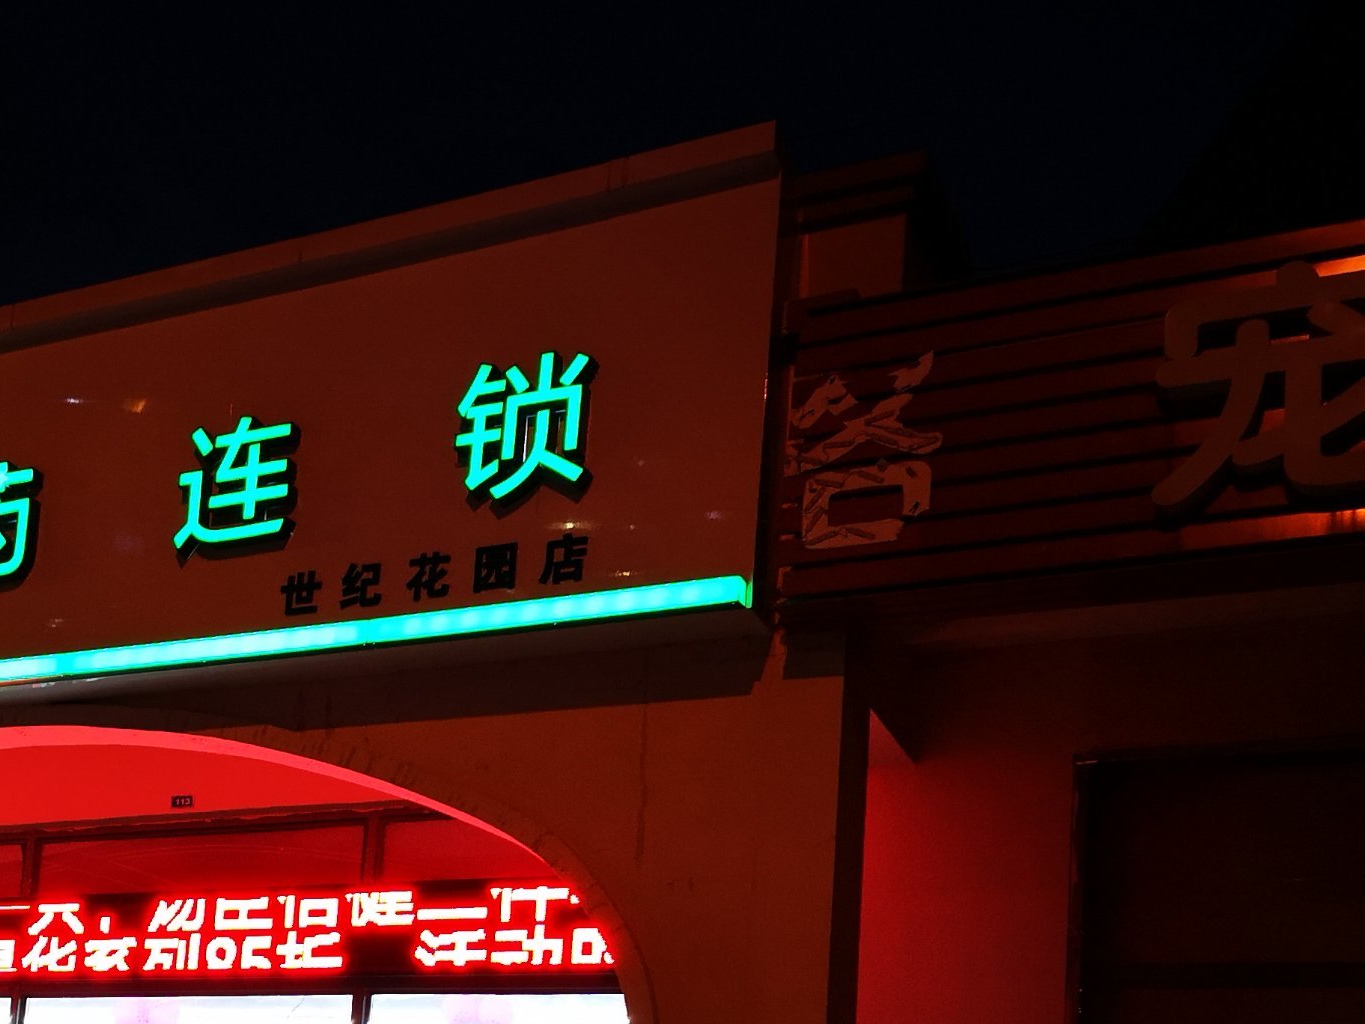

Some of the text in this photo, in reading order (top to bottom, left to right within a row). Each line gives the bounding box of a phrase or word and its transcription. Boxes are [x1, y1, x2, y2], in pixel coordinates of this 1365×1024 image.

[281, 532, 589, 617] 世纪花园店
